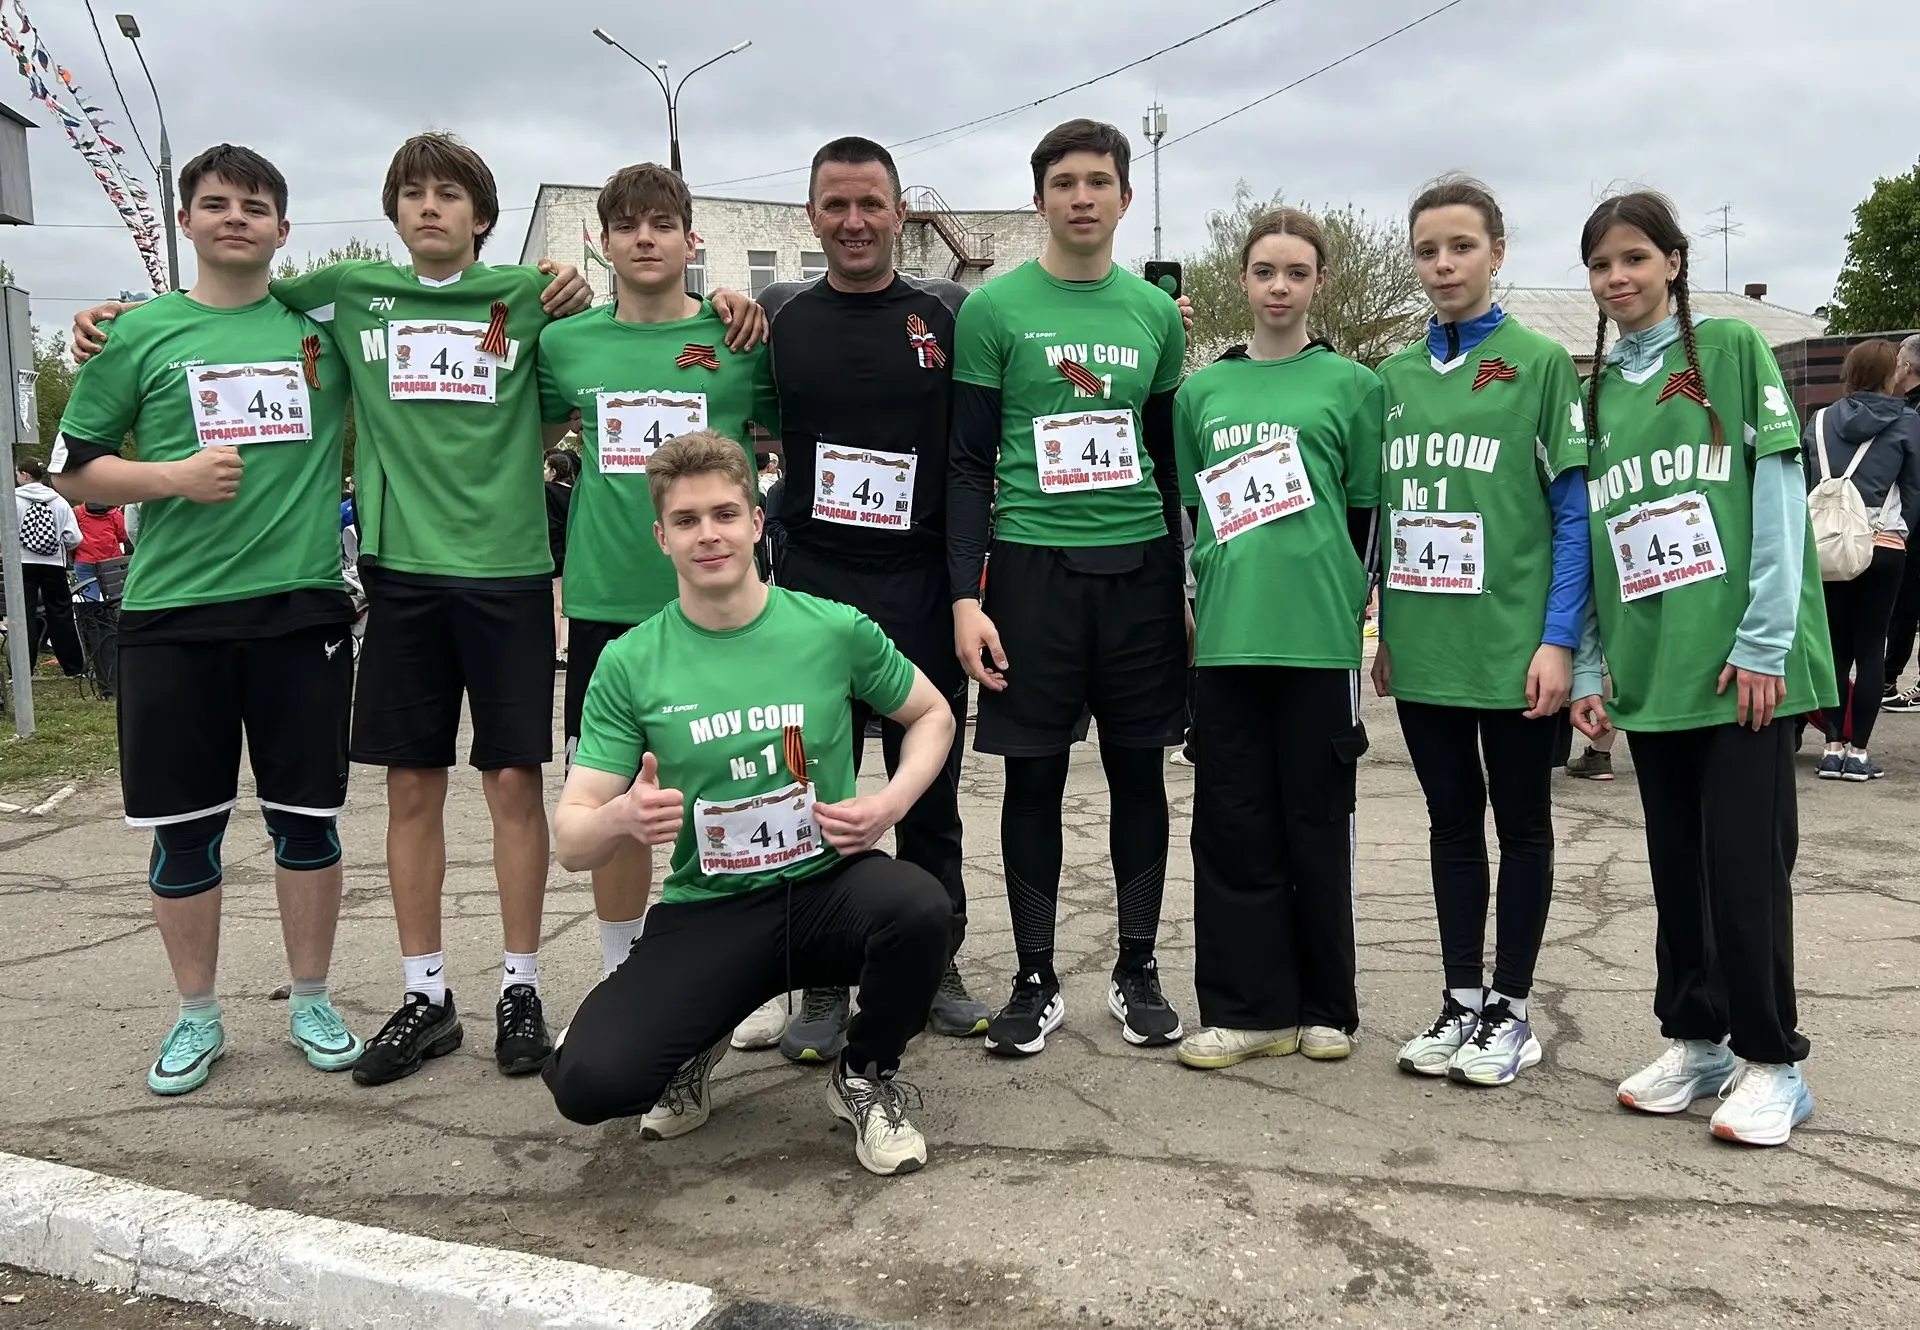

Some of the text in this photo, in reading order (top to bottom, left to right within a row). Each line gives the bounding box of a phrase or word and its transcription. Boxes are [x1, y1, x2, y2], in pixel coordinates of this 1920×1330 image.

[430, 347, 464, 380] 46
[1045, 343, 1139, 369] МОУ СОШ
[391, 381, 487, 395] ГОРОДСКАЯ ЭСТАФЕТА
[585, 386, 605, 394] SPORT
[247, 390, 284, 421] 48
[200, 423, 305, 440] ГОРОДСКАЯ ЭСТАФЕТА
[1212, 422, 1253, 452] МОУ
[601, 455, 649, 467] ГОРОДСКА
[1081, 437, 1111, 468] 44
[1425, 432, 1501, 474] СОШ
[1041, 469, 1134, 486] ГОРОДСКАЯ ЭСТАФЕТА
[1243, 475, 1275, 504] 43
[1587, 444, 1732, 513] МОУ СОШ
[852, 478, 884, 510] 49
[1402, 477, 1447, 511] № 1
[815, 504, 902, 525] ГОРОДСКАЯ ЭСТАФЕТА
[1216, 510, 1259, 539] ГОРОДСКАЯ
[1259, 494, 1305, 519] ЭСТАФЕТА
[1418, 541, 1450, 574] 47
[1647, 533, 1683, 566] 45
[1389, 572, 1473, 589] ГОРОДСКАЯ ЭСТАФЕТА
[1622, 574, 1662, 596] ГОРОДСКАЯ
[1663, 559, 1716, 583] ЭСТАФЕТА
[673, 703, 699, 712] SPORT
[688, 703, 804, 745] МОУ СОШ
[729, 744, 778, 781] № 1
[750, 820, 787, 849] 41
[702, 841, 813, 870] ГОРОДСКАЯ ЭСТАФЕТА
